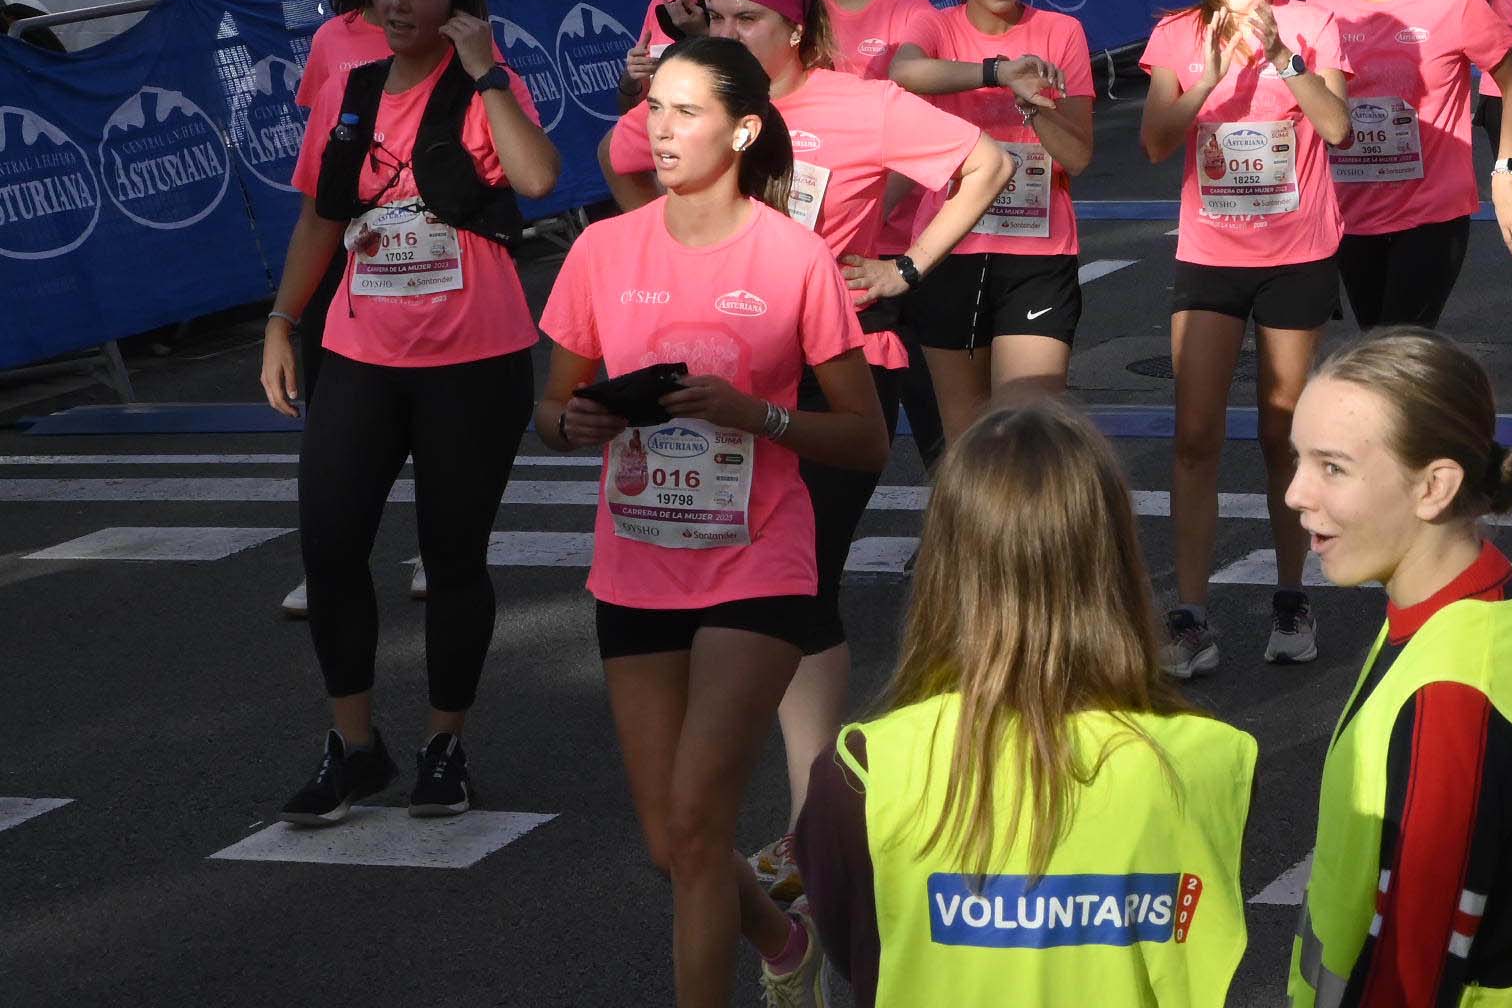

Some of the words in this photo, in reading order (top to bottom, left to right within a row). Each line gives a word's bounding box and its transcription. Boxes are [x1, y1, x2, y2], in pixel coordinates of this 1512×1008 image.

[1226, 137, 1264, 147] ASTURIANA
[1357, 130, 1386, 142] 016
[1229, 158, 1263, 172] 016
[1233, 175, 1260, 185] 18252
[1208, 200, 1236, 208] OYSHO
[381, 232, 418, 249] 016
[385, 251, 414, 262] 17032
[362, 279, 393, 288] OYSHO
[417, 276, 453, 286] Santander
[620, 289, 670, 305] OYSHO
[651, 438, 704, 452] ASTURIANA
[652, 468, 701, 488] 016
[657, 494, 694, 506] 19798
[622, 507, 658, 518] CARRERA
[660, 511, 669, 519] DE
[685, 513, 713, 521] MUJER
[622, 522, 660, 536] OYSHO
[693, 530, 737, 541] Santander
[935, 892, 1173, 929] VOLUNTARIS
[1175, 878, 1198, 941] 2000
